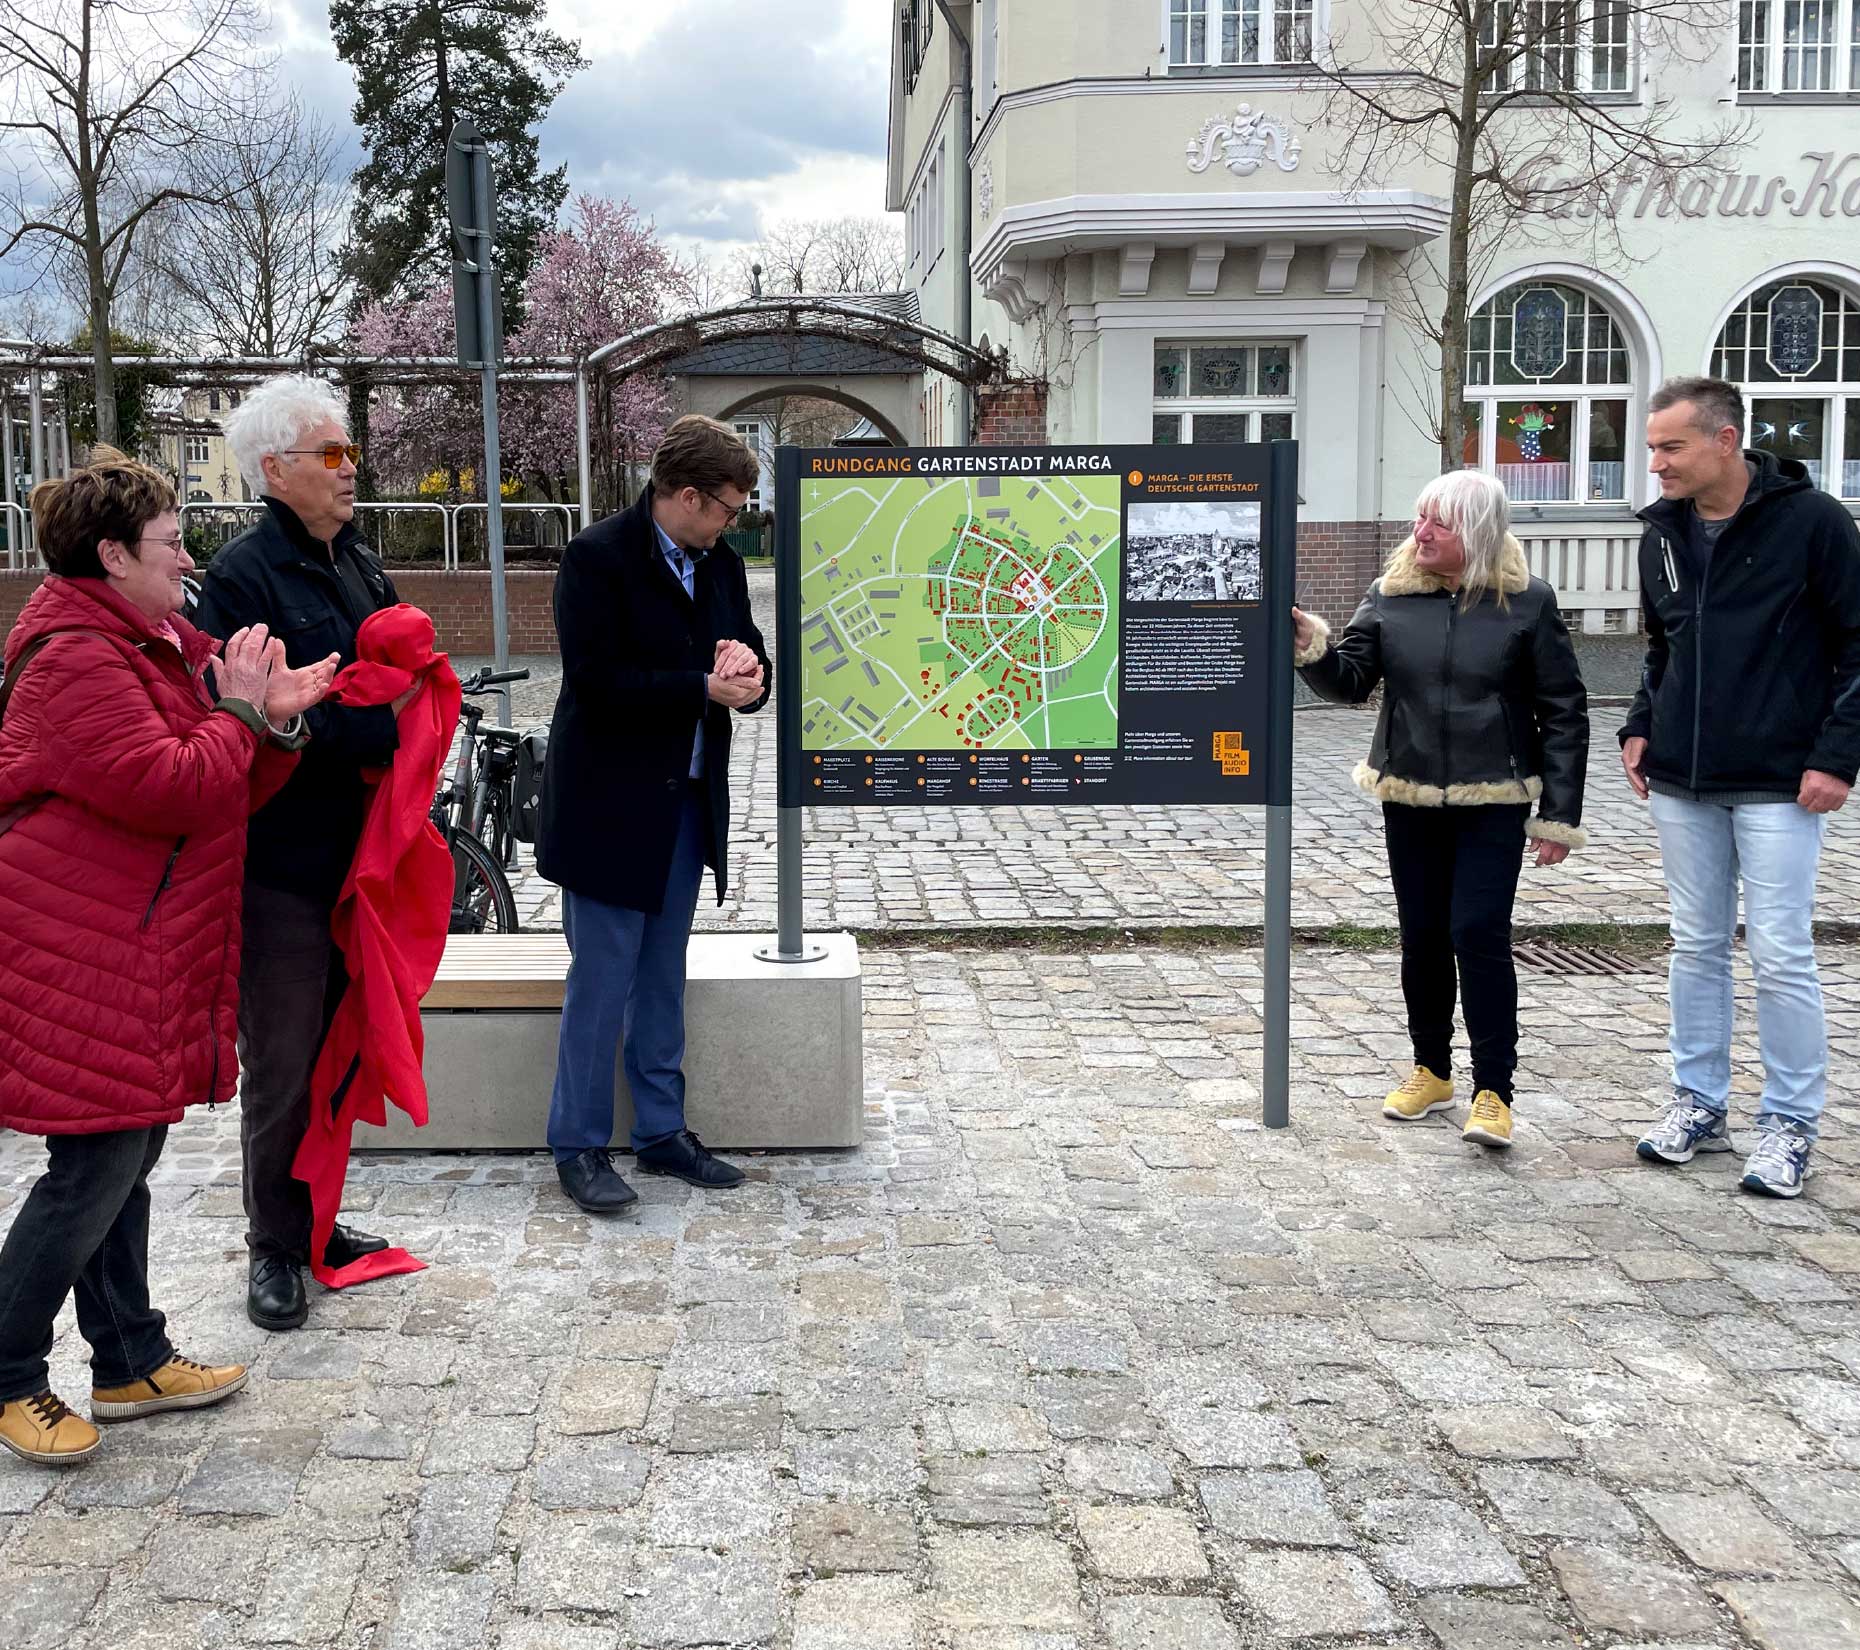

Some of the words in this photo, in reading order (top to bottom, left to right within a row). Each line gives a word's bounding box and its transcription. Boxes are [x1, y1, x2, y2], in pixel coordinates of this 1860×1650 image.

[812, 457, 912, 472] RUNDGANG
[917, 456, 1043, 472] GARTENSTADT
[1049, 455, 1112, 470] MARGA
[1147, 474, 1179, 482] MARGA
[1188, 474, 1204, 482] DIE
[1206, 473, 1233, 482] ERSTE
[1147, 484, 1194, 493] DEUTSCHE
[1196, 483, 1260, 492] GARTENSTADT
